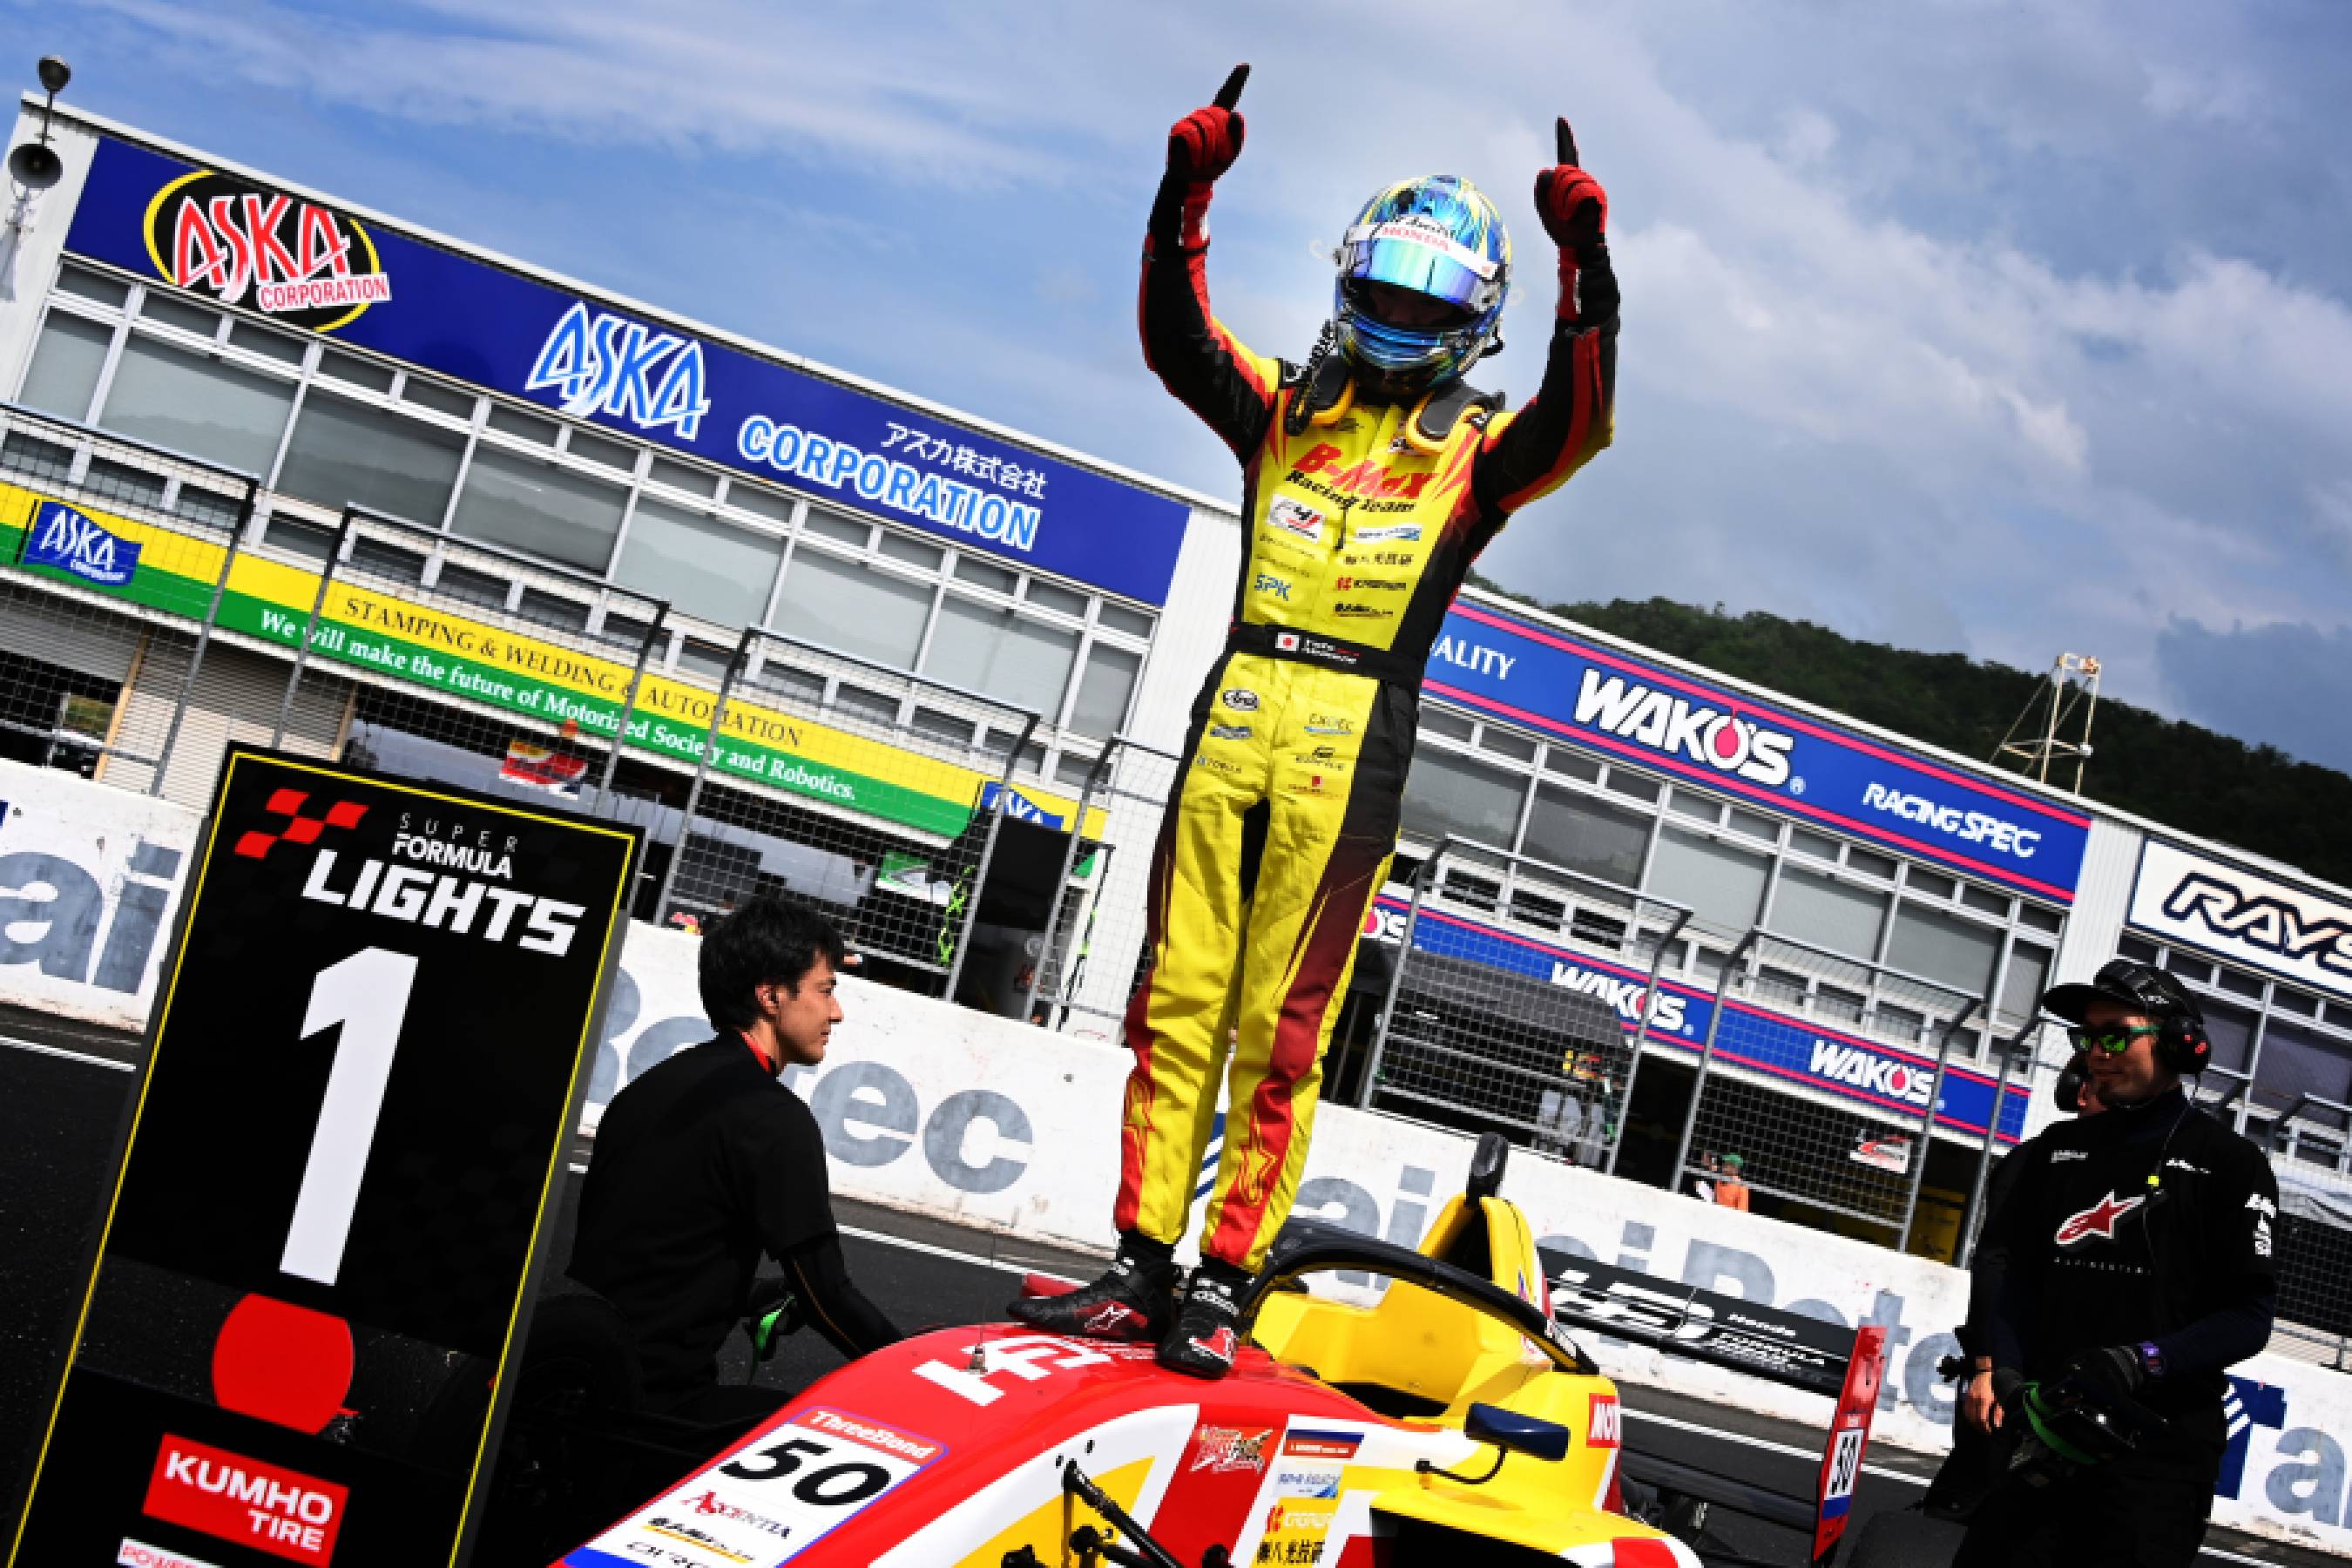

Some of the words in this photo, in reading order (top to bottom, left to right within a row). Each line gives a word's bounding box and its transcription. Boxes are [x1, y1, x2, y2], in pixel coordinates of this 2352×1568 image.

[174, 193, 350, 302] ASKA
[261, 279, 389, 309] CORPORATION
[525, 301, 710, 440] ASKA
[739, 414, 1041, 551] CORPORATION
[884, 420, 1048, 501] アスカ株式会社
[39, 509, 116, 571] ASKA
[344, 598, 476, 652] STAMPING
[480, 640, 497, 660] &
[505, 644, 614, 694] WELDING
[1430, 634, 1517, 680] ALITY
[261, 609, 296, 637] We
[348, 637, 407, 672] make
[410, 654, 446, 681] the
[448, 665, 516, 702] future
[517, 691, 543, 714] of
[652, 725, 723, 767] Sociey
[727, 747, 767, 775] and
[391, 833, 513, 881] FORMULA
[399, 812, 519, 854] SUPER
[1862, 781, 1964, 835] RACING
[1957, 810, 2042, 858] SPEC
[301, 848, 589, 956] LIGHTS
[280, 946, 419, 1287] 1
[718, 1436, 891, 1506] 50
[809, 1409, 936, 1460] ThreeBond
[165, 1449, 334, 1526] KUMHO
[247, 1508, 327, 1553] TIRE
